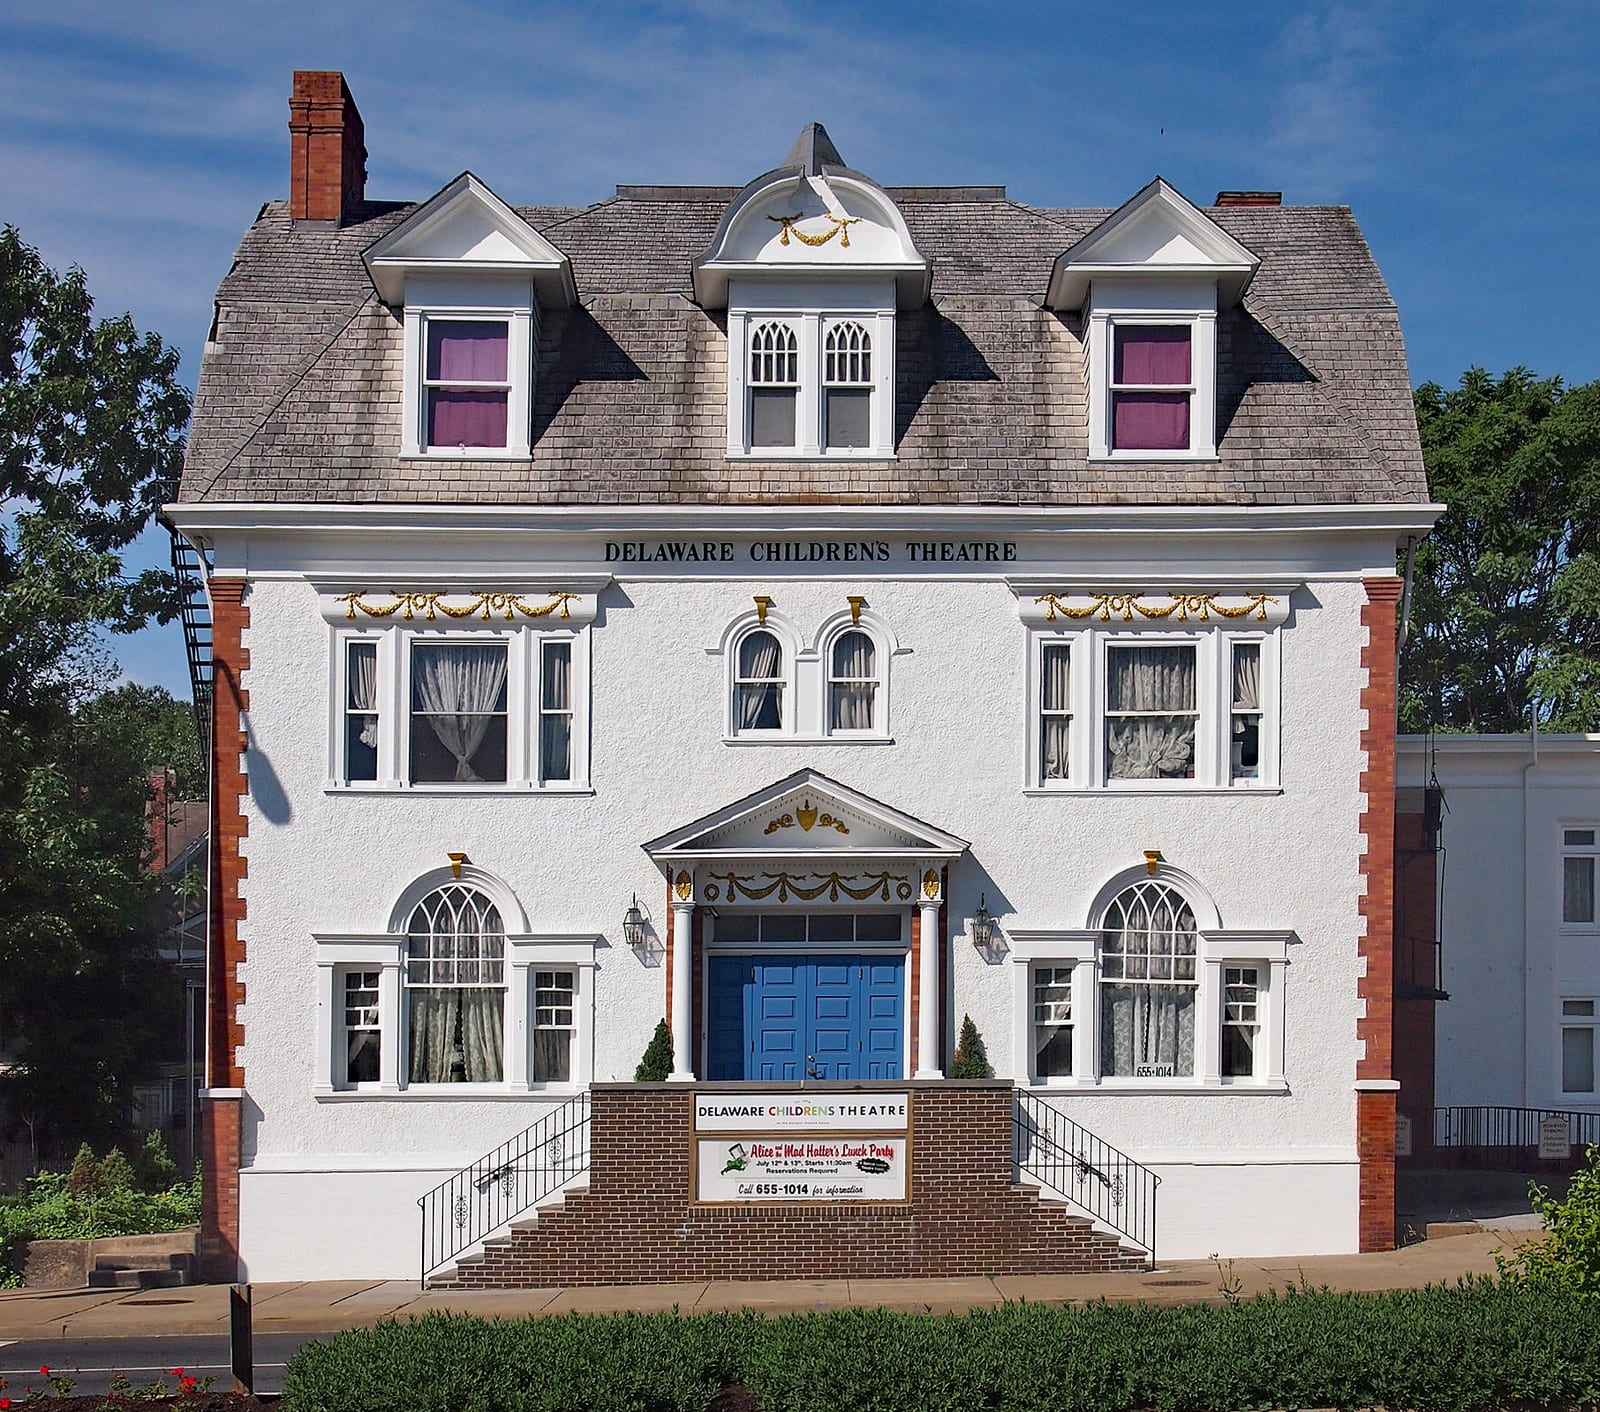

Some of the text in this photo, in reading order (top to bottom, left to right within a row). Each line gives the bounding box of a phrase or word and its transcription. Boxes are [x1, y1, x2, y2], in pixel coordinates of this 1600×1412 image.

[604, 541, 1017, 562] DELAWARE CHILDREN'S THEATRE
[699, 1105, 905, 1117] DELAWARE CHILDRENS THEATRE
[750, 1144, 774, 1158] Alice
[784, 1144, 804, 1158] Mad
[806, 1144, 840, 1158] Hatter's
[841, 1144, 867, 1158] Lunch
[869, 1144, 894, 1161] Party
[738, 1184, 863, 1197] Call 655-1014 for information
